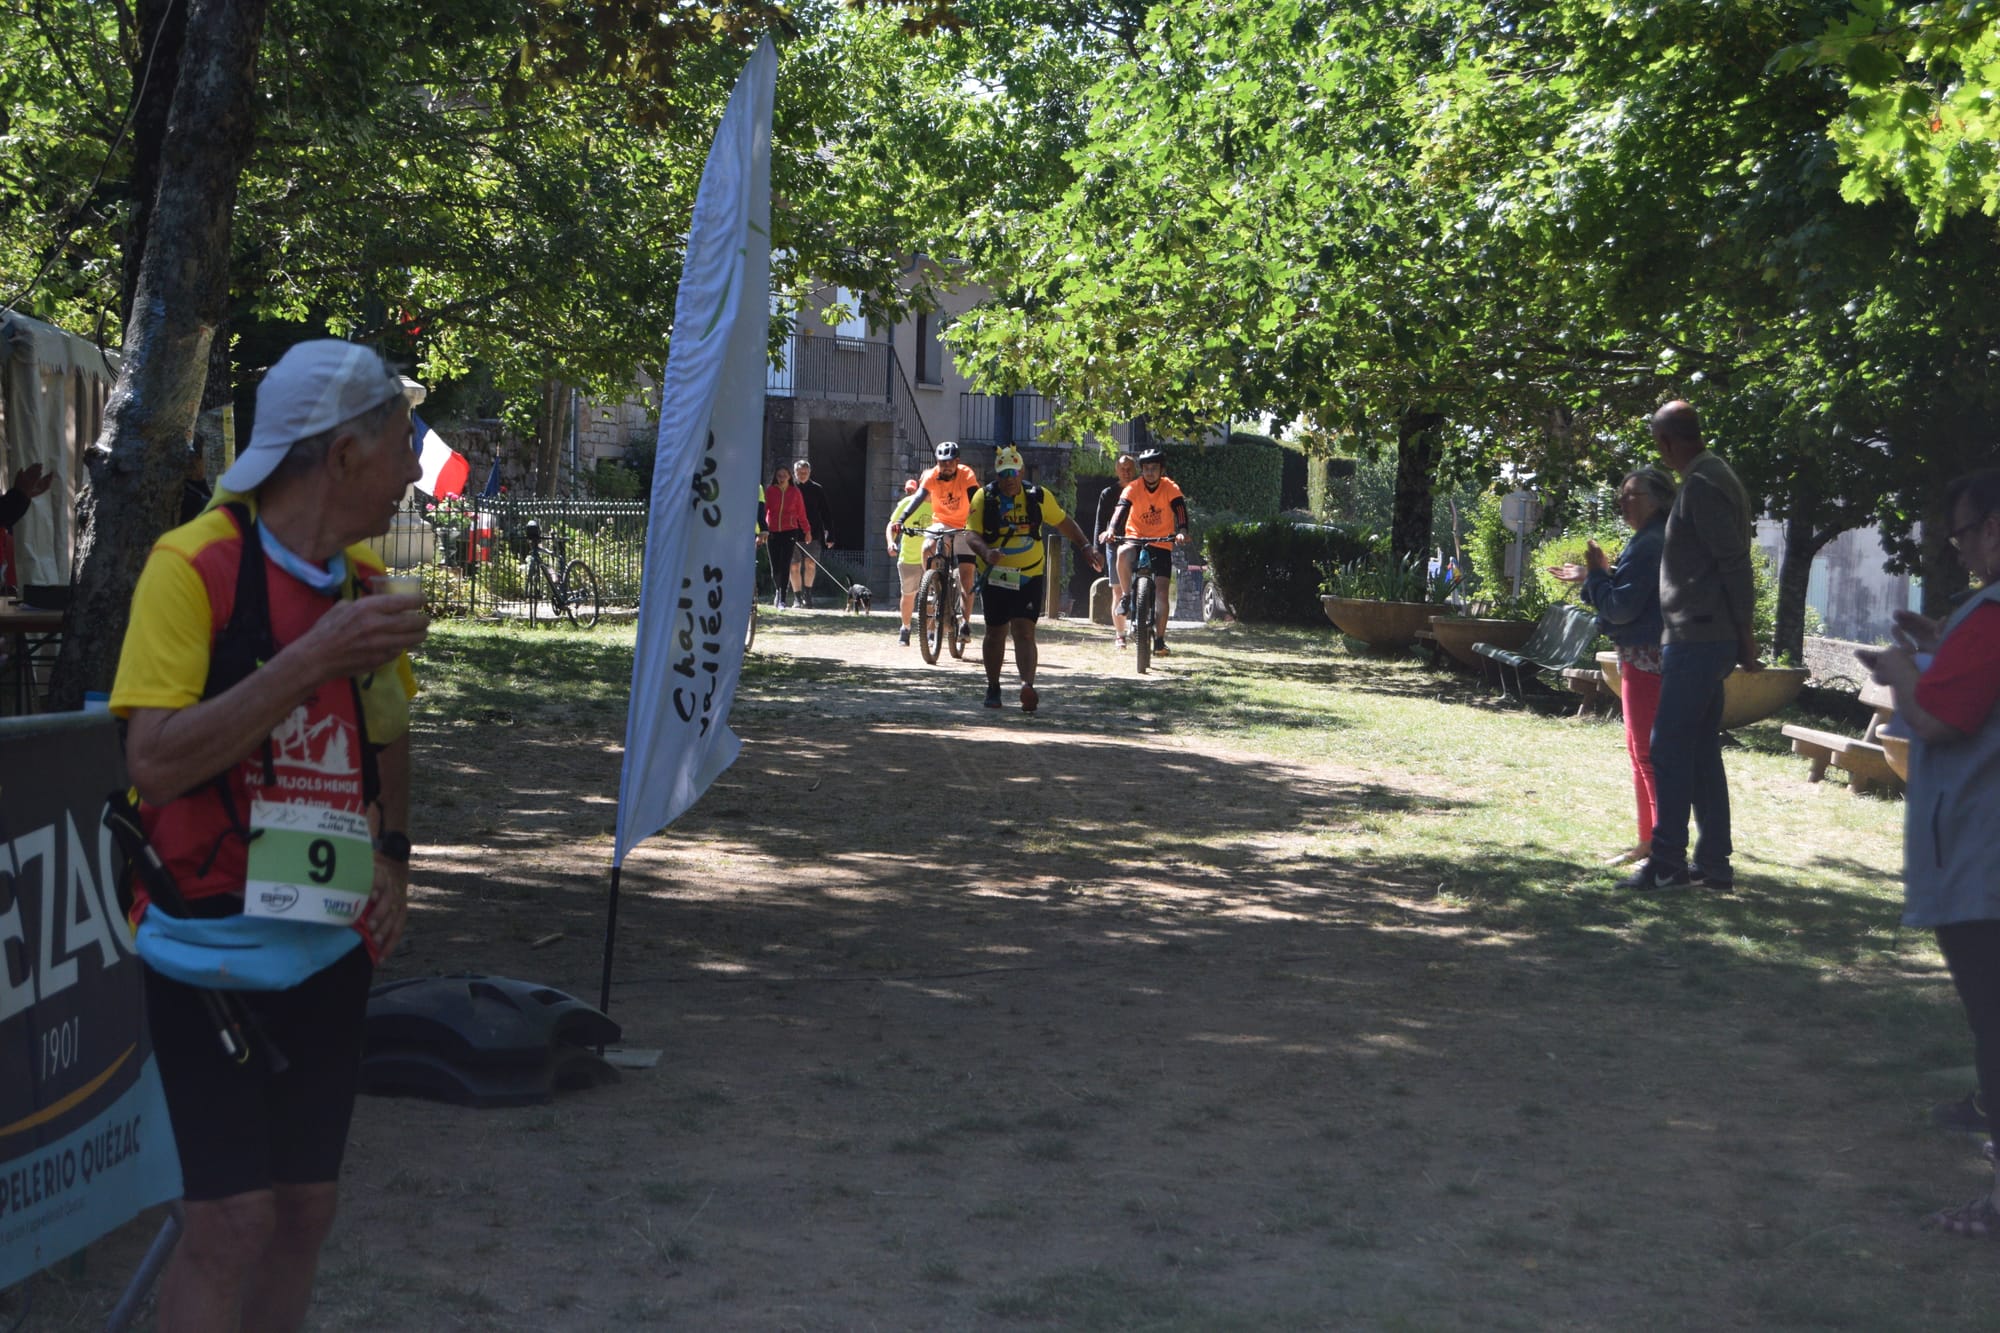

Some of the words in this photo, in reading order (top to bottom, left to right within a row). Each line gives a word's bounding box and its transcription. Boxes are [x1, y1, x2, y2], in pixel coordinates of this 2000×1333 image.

[1000, 572, 1008, 582] 4
[308, 839, 335, 884] 9
[41, 1016, 80, 1081] 1901
[81, 1114, 141, 1184] QUÉZAC
